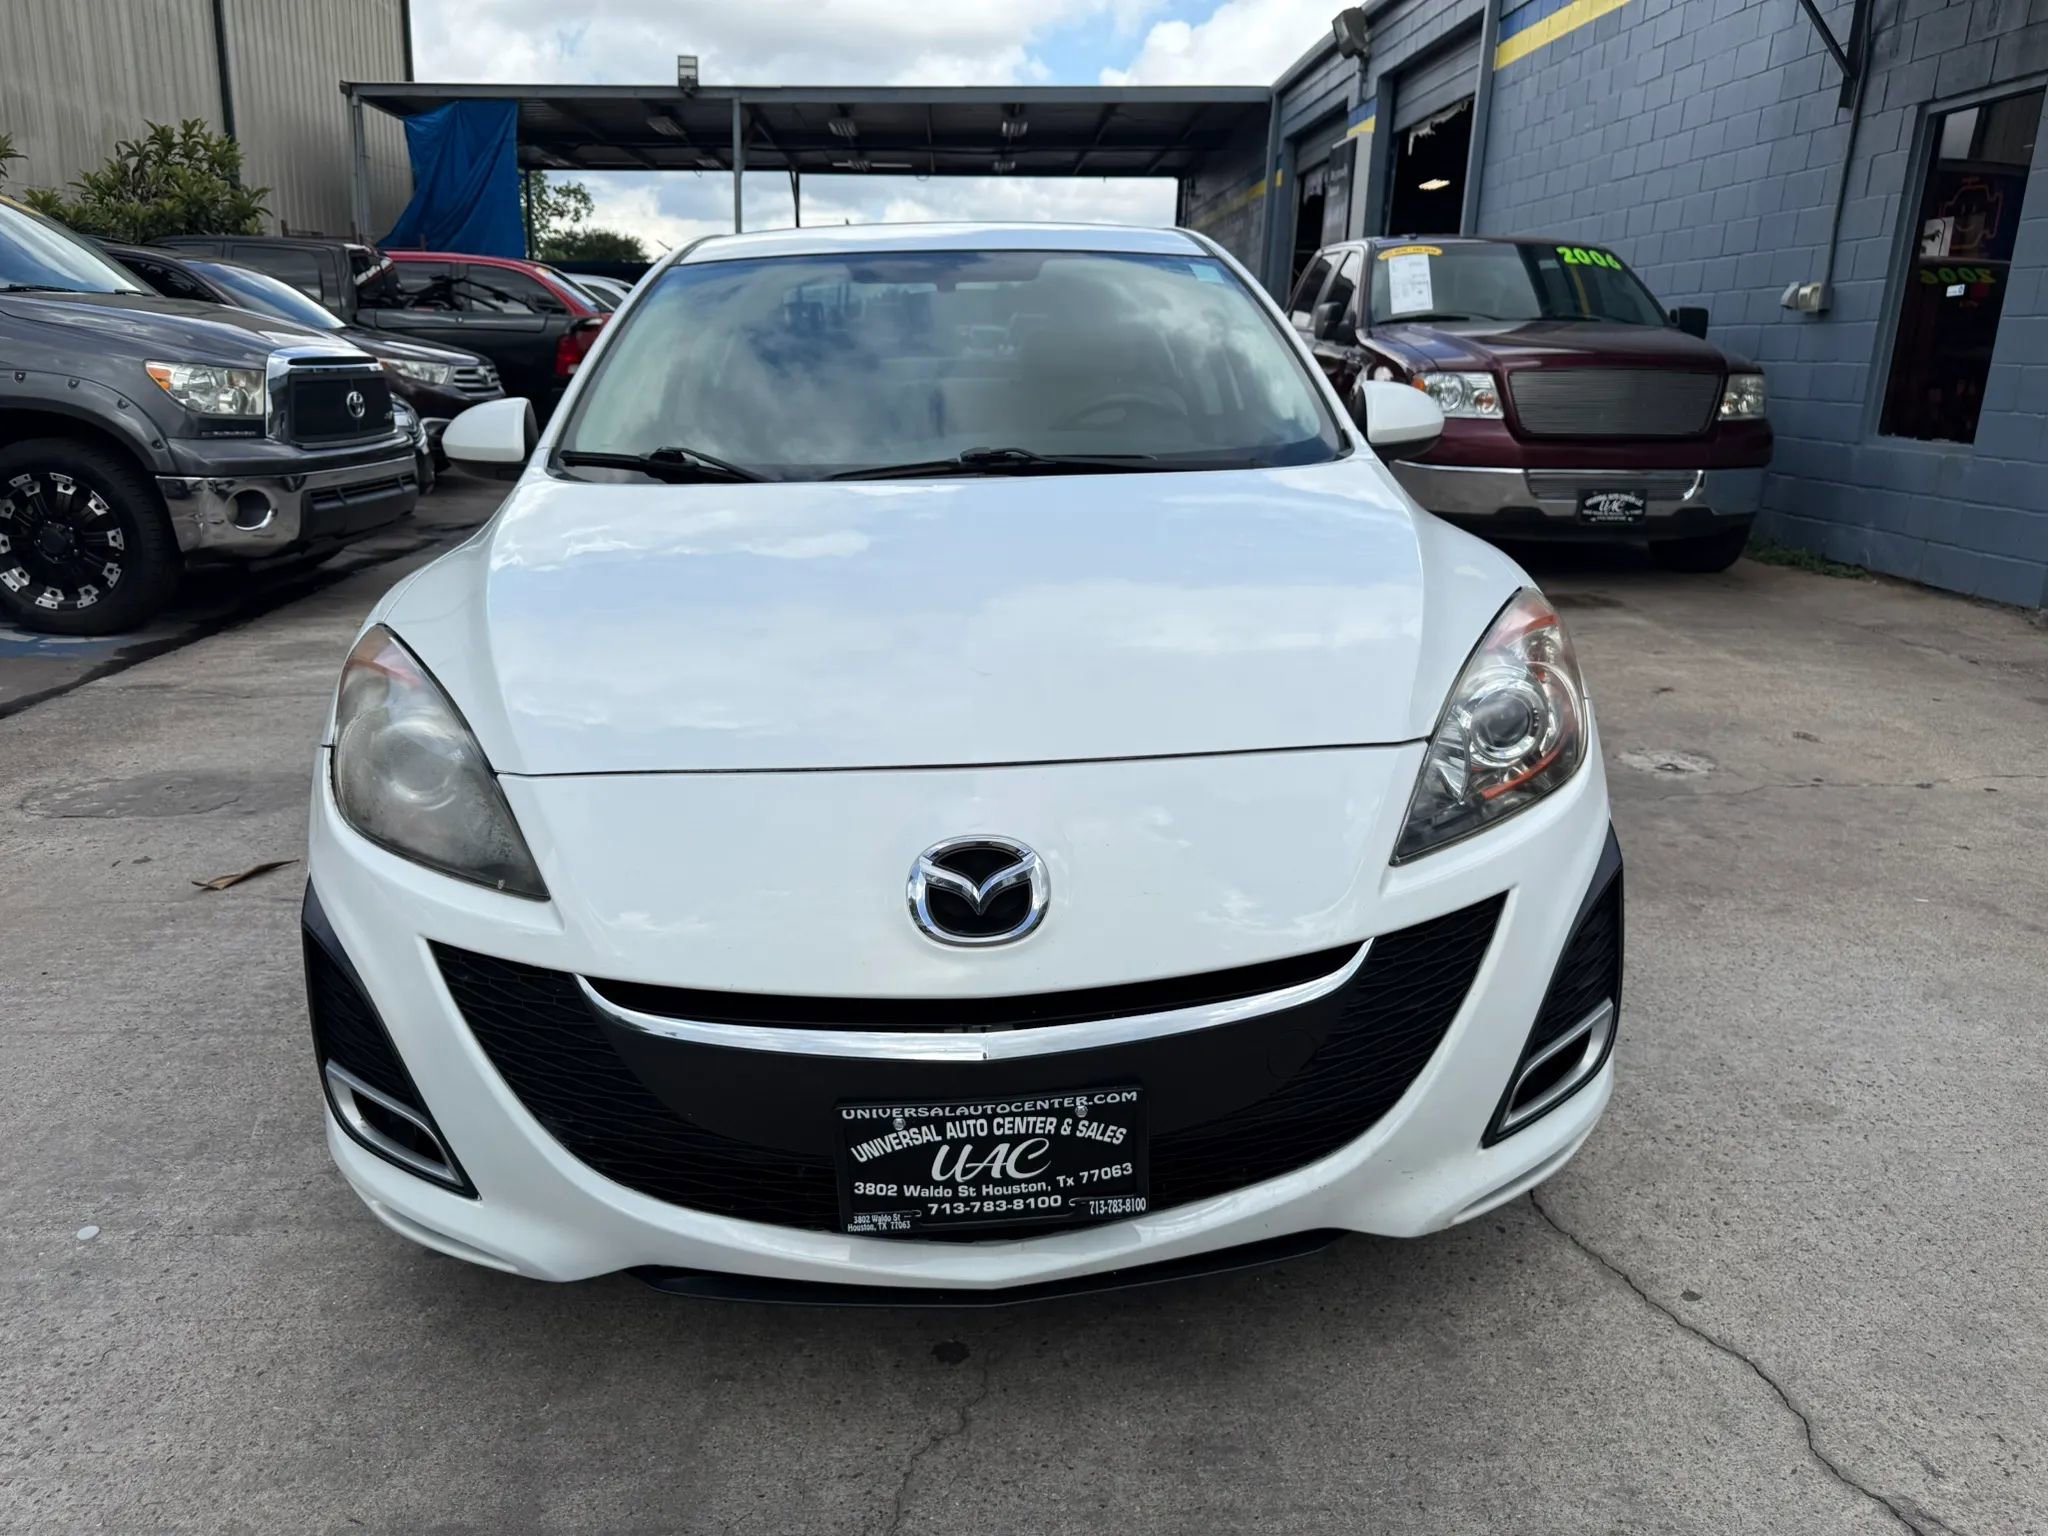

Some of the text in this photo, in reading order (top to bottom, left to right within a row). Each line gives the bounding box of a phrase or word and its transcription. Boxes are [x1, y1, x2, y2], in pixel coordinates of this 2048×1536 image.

[1555, 246, 1622, 271] 2006
[842, 1091, 1137, 1119] UNIVERSALAUTOCENTER.COM
[850, 1116, 1127, 1163] UNIVERSAL AUTO CENTER & SALES
[931, 1138, 1051, 1183] UAC
[854, 1162, 1133, 1197] 3802 Waldo St Houston, Tx 77063
[927, 1195, 1062, 1215] 713-783-8100
[1089, 1198, 1147, 1216] 713-783-8100
[853, 1213, 901, 1224] 3802 Waldo St
[877, 1221, 888, 1230] TX
[890, 1220, 911, 1230] 77063
